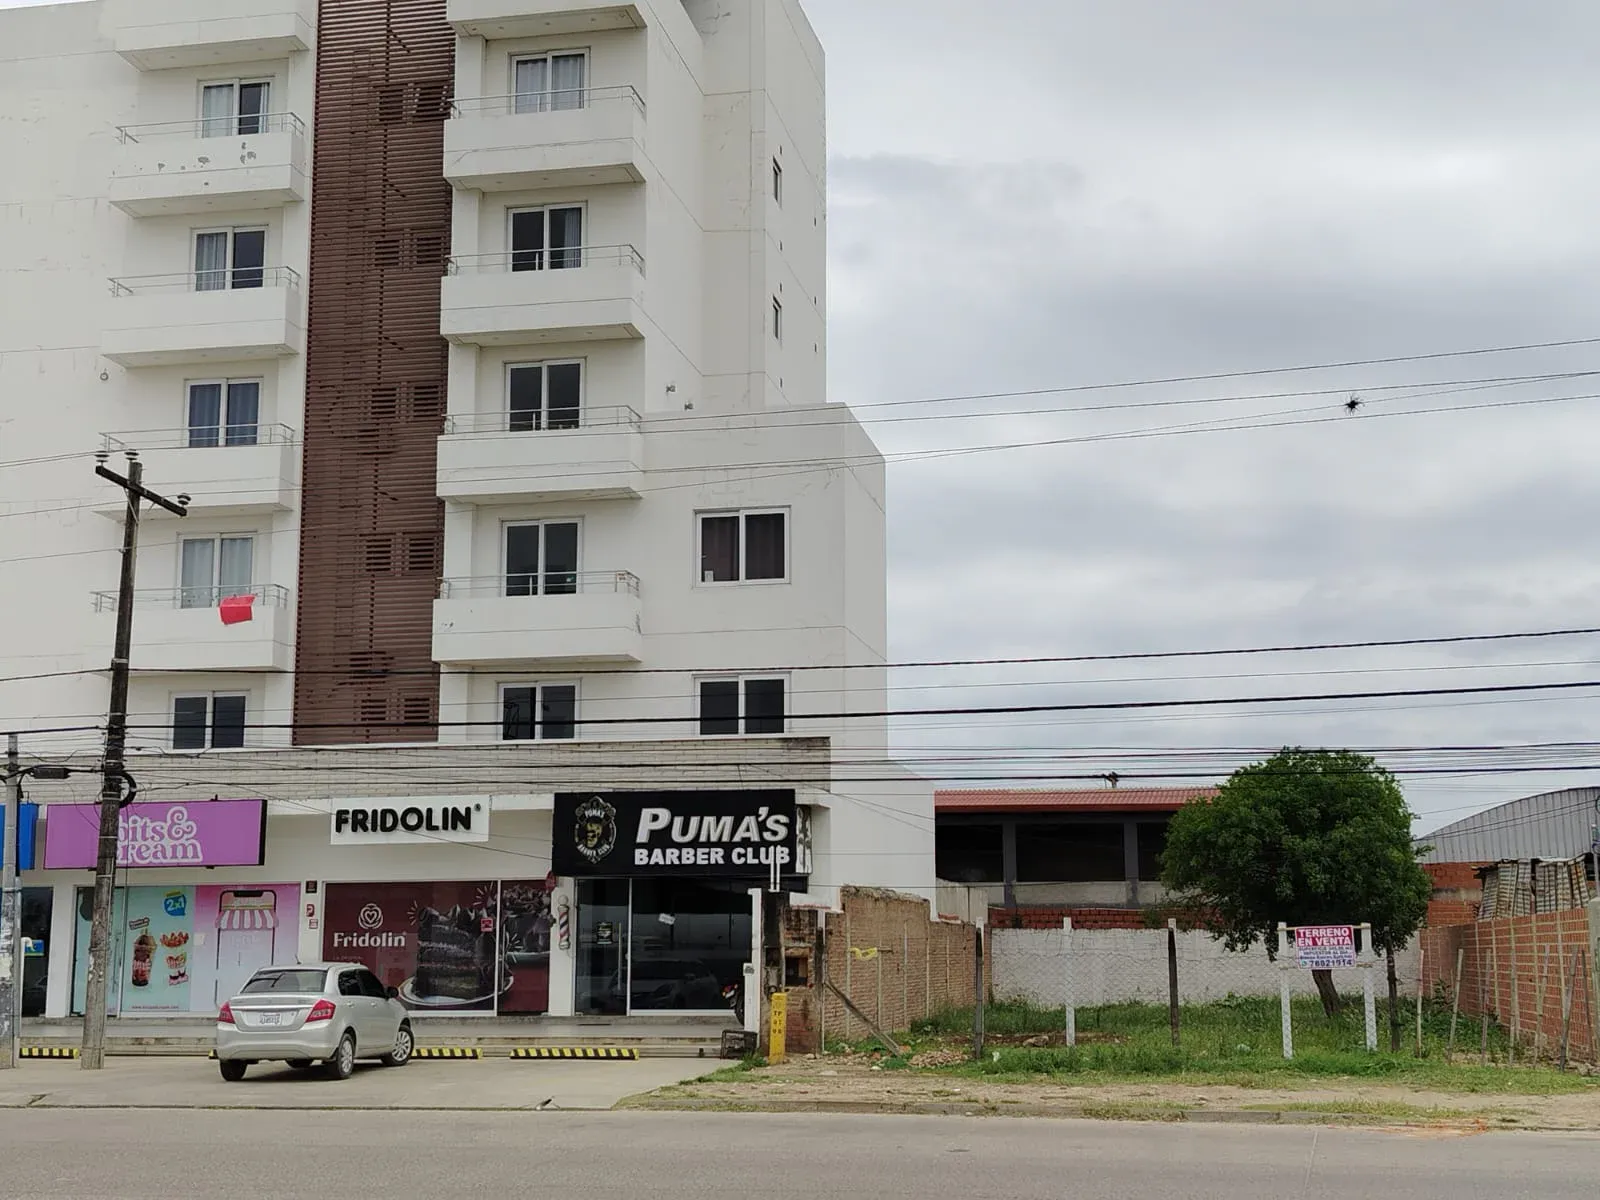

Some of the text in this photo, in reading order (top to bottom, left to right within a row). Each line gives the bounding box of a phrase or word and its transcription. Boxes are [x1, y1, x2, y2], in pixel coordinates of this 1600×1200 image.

[335, 806, 472, 833] FRIDOLIN
[635, 806, 791, 844] PUMA'S
[117, 842, 201, 861] ream
[634, 846, 791, 865] BARBER CLUB
[333, 931, 406, 948] Fridolin
[1298, 928, 1350, 938] TERRENO
[1298, 936, 1352, 947] EN VENTA
